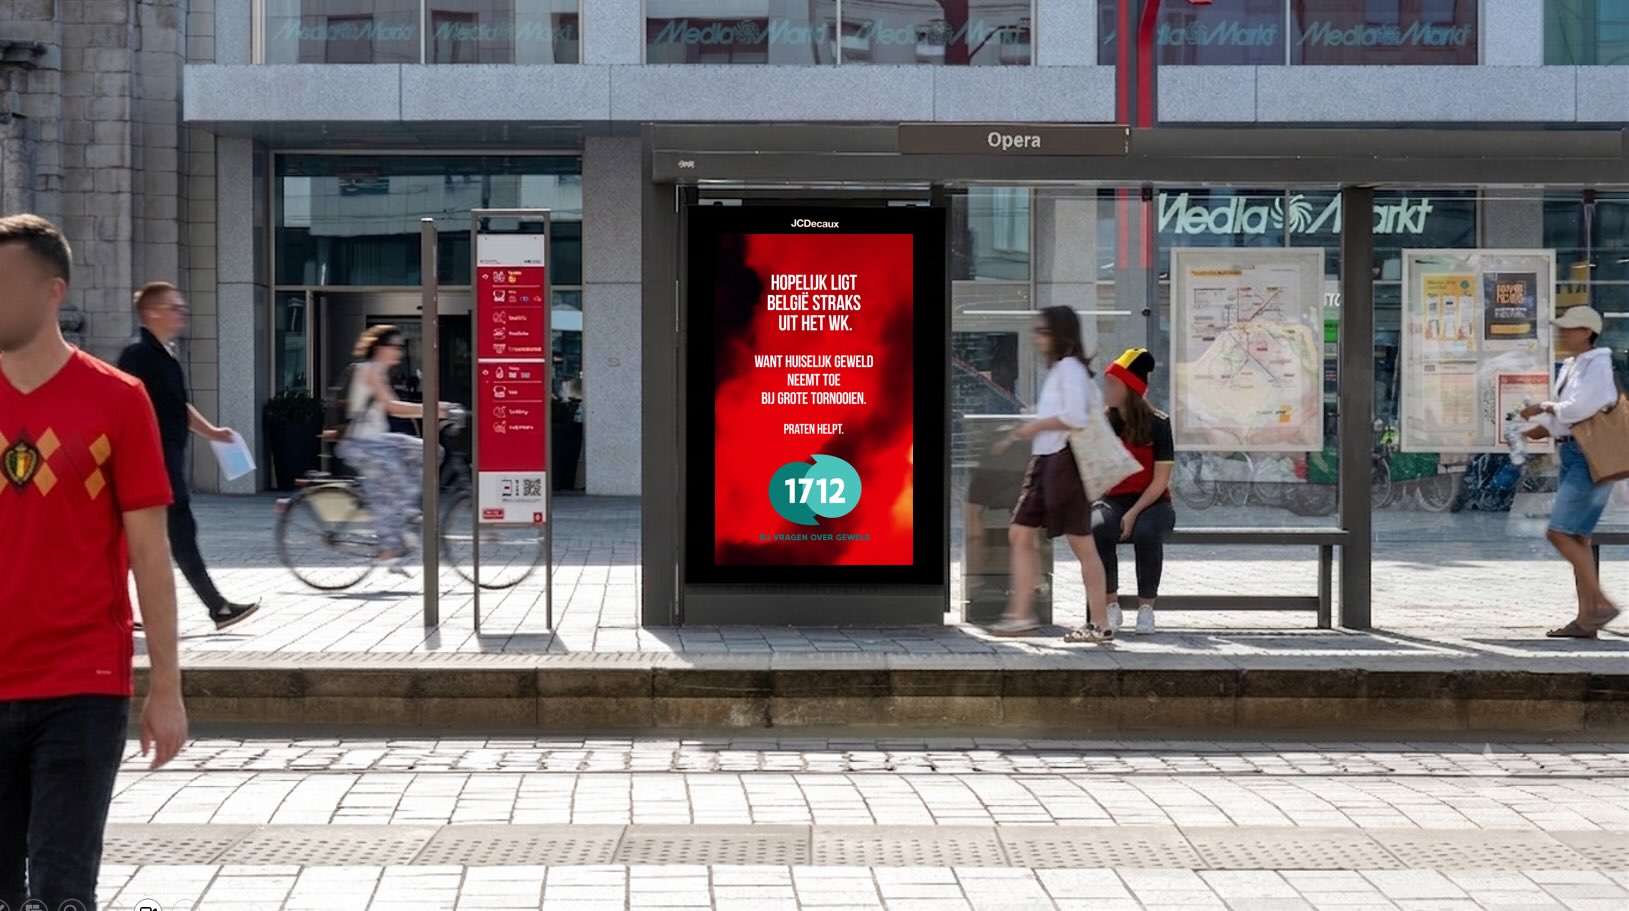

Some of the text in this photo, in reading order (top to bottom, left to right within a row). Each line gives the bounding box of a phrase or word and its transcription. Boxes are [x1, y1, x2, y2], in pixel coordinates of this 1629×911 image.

[653, 19, 734, 45] Media
[1202, 20, 1278, 46] Markt
[1296, 20, 1472, 46] Media Markt
[987, 131, 1041, 151] Opera
[790, 218, 839, 229] JCDecaux
[771, 274, 858, 291] HOPELIJK LIGT
[767, 291, 861, 311] BELGIË STRAKS
[778, 314, 853, 331] UIT HET WK.
[754, 354, 874, 368] WANT HUISELIJK GEWELD
[787, 373, 841, 387] NEEMT TOE
[761, 391, 867, 405] BIJ GROTE TORNOOIEN.
[783, 423, 845, 435] PRATEN HELPT.
[784, 477, 846, 504] 1712
[773, 533, 808, 541] VRAGEN
[810, 533, 834, 541] OVER
[835, 533, 871, 541] GEWELD
